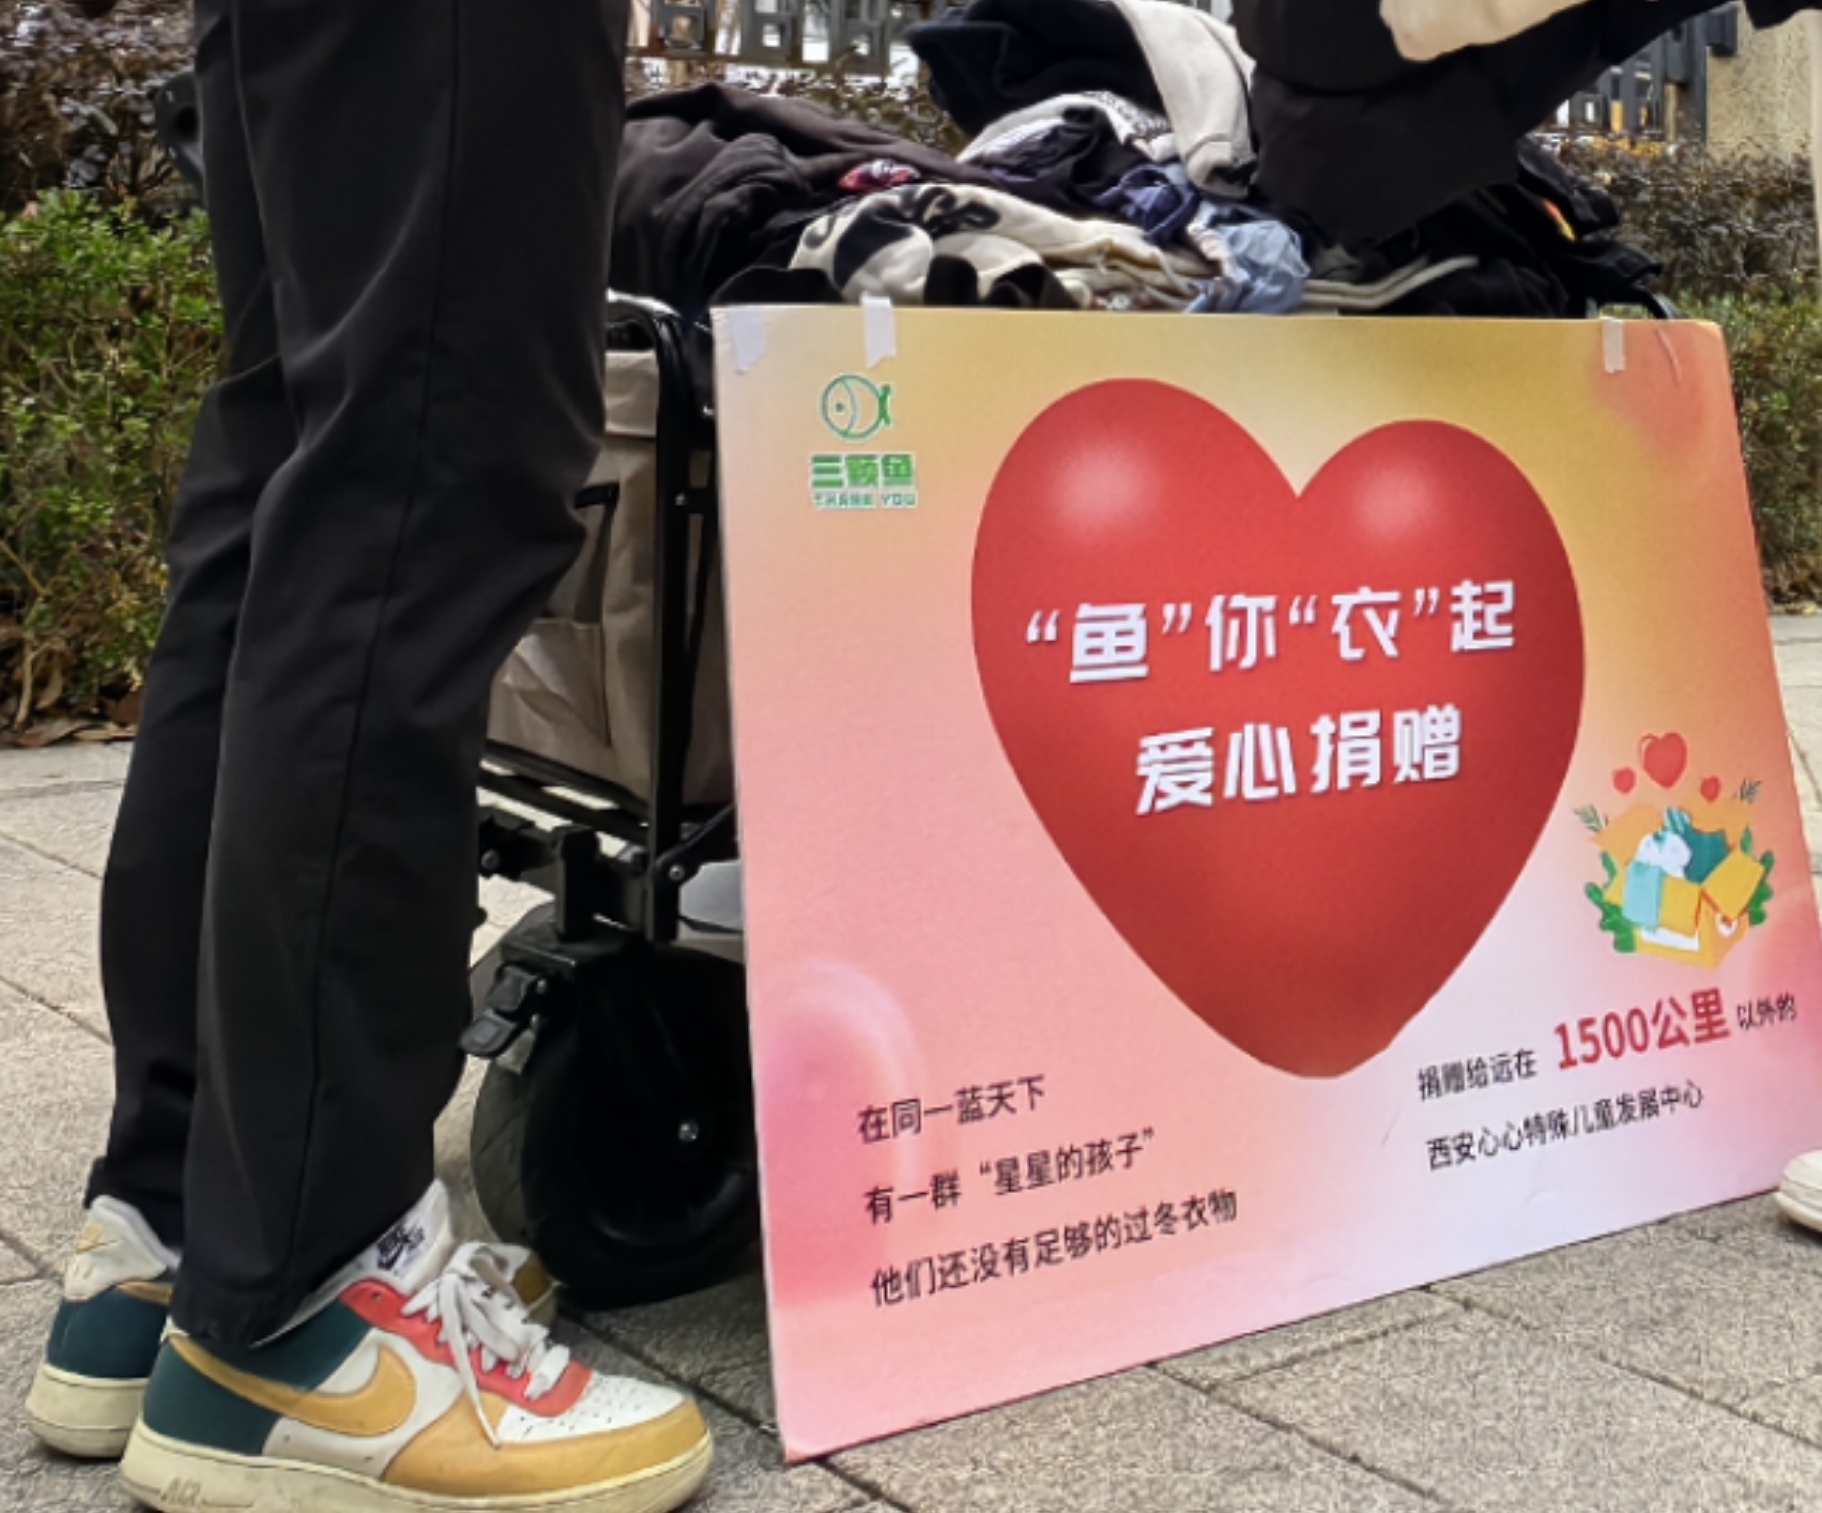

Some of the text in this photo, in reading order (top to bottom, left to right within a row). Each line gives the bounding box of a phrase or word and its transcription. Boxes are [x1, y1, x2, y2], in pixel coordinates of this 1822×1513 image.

[811, 453, 914, 488] 三颗鱼
[1136, 703, 1462, 816] 爱心捐赠
[1417, 987, 1797, 1101] 捐赠给远在 1500公里 以外的
[857, 1074, 1047, 1145] 在同一蓝天下
[1426, 1079, 1704, 1172] 西安心心特殊儿童发展中心
[870, 1188, 1239, 1308] 他们还没有足够的过冬衣物
